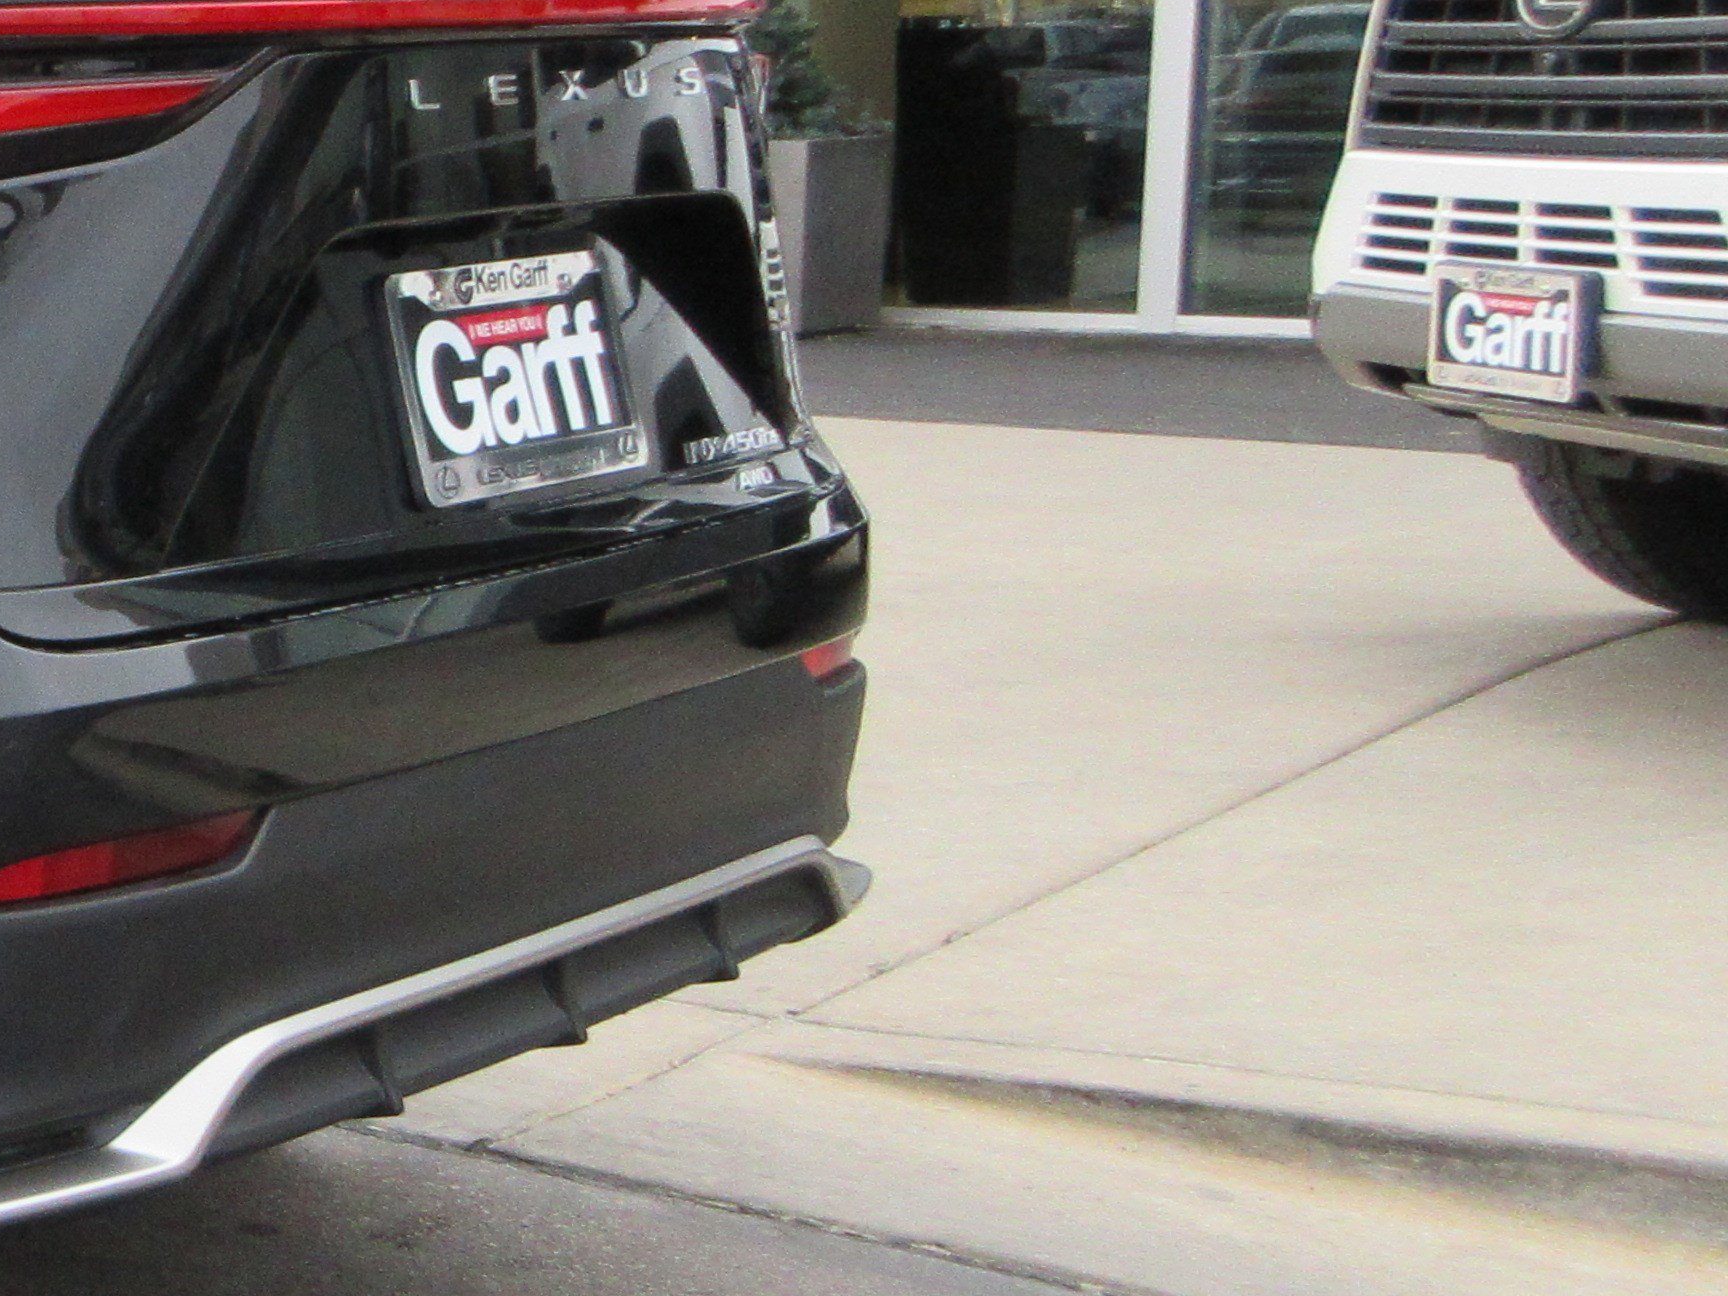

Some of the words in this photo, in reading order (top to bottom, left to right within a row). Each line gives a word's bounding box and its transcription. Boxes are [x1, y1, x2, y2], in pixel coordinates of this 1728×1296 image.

[408, 66, 705, 110] LEXUS
[473, 266, 508, 294] Ken
[510, 260, 549, 290] Garff
[475, 321, 492, 338] WE
[493, 318, 515, 336] HEAR
[516, 316, 537, 333] YOU
[1445, 291, 1568, 373] Garff
[416, 301, 612, 454] Garff
[739, 466, 775, 492] AWD
